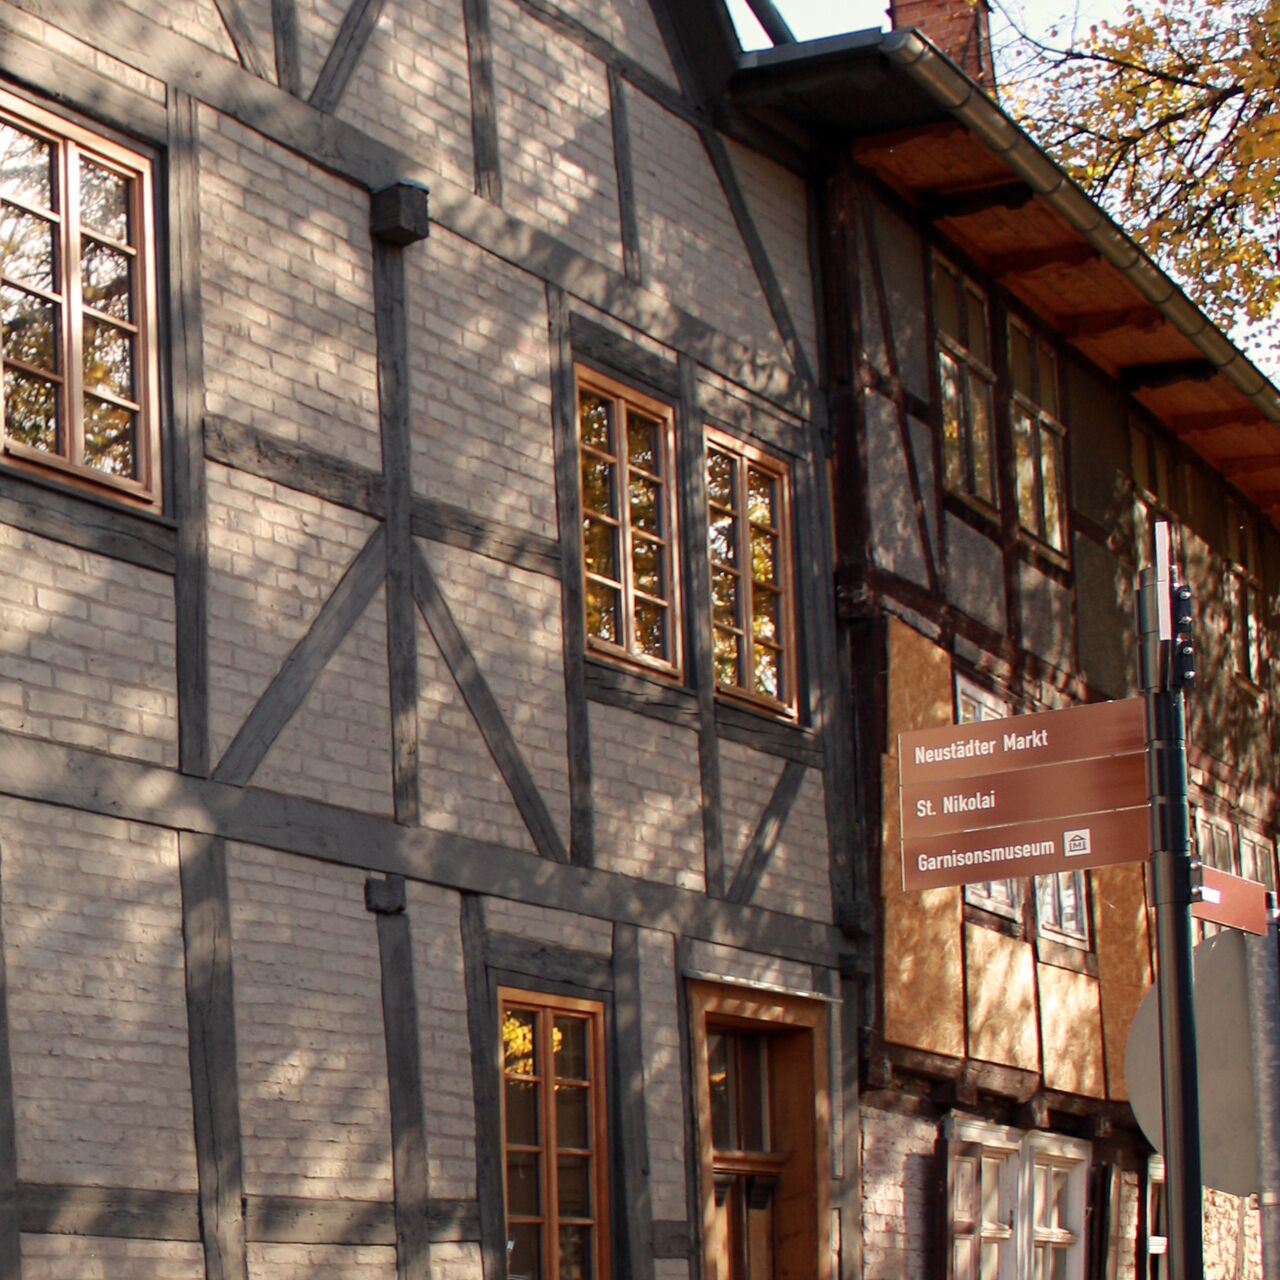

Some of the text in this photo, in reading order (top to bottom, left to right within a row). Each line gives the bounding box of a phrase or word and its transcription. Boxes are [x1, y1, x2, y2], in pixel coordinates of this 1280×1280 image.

[914, 729, 1048, 764] Neustädter Markt
[916, 790, 995, 817] St. Nikolai
[917, 840, 1055, 871] Garnisonsmuseum
